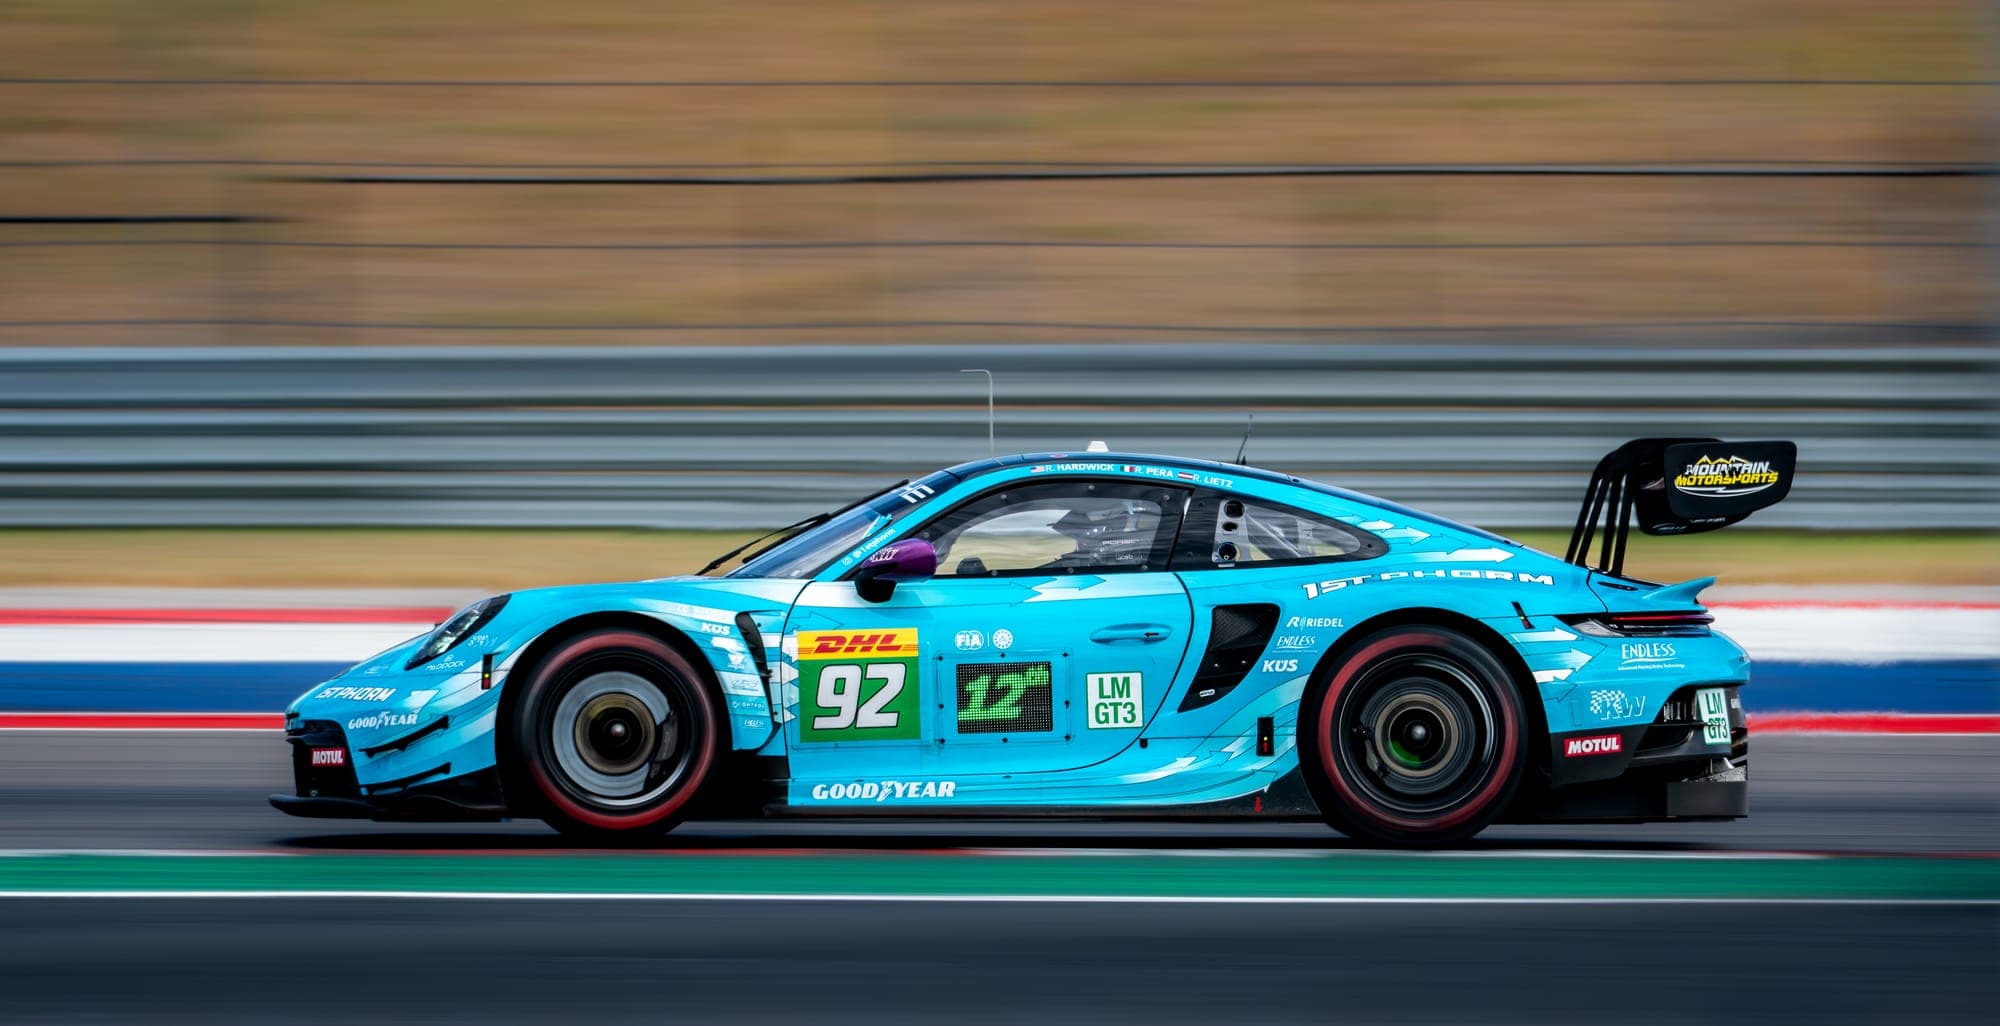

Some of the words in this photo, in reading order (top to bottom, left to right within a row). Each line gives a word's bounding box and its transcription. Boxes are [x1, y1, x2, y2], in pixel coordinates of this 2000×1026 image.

[1057, 463, 1114, 472] HARDWICK
[1146, 468, 1173, 478] PERA
[1685, 461, 1770, 476] MOUNTAIN
[1204, 477, 1233, 488] LIETZ
[1674, 472, 1779, 487] MOTORSPORTS
[1306, 617, 1344, 628] RIEDEL
[814, 633, 903, 654] DHL
[956, 631, 982, 647] FIA
[1277, 635, 1316, 647] ENDLESS
[1621, 642, 1677, 659] ENDLESS
[1262, 659, 1299, 673] KÜS
[1098, 676, 1132, 699] LM
[812, 662, 908, 731] 92
[1705, 692, 1723, 714] LM
[348, 711, 418, 730] GOODYEAR
[1095, 702, 1137, 724] GT3
[1708, 716, 1728, 740] GT3
[1567, 737, 1620, 754] MOTUL
[312, 750, 344, 764] MOTUL
[812, 780, 957, 802] GOODYEAR
